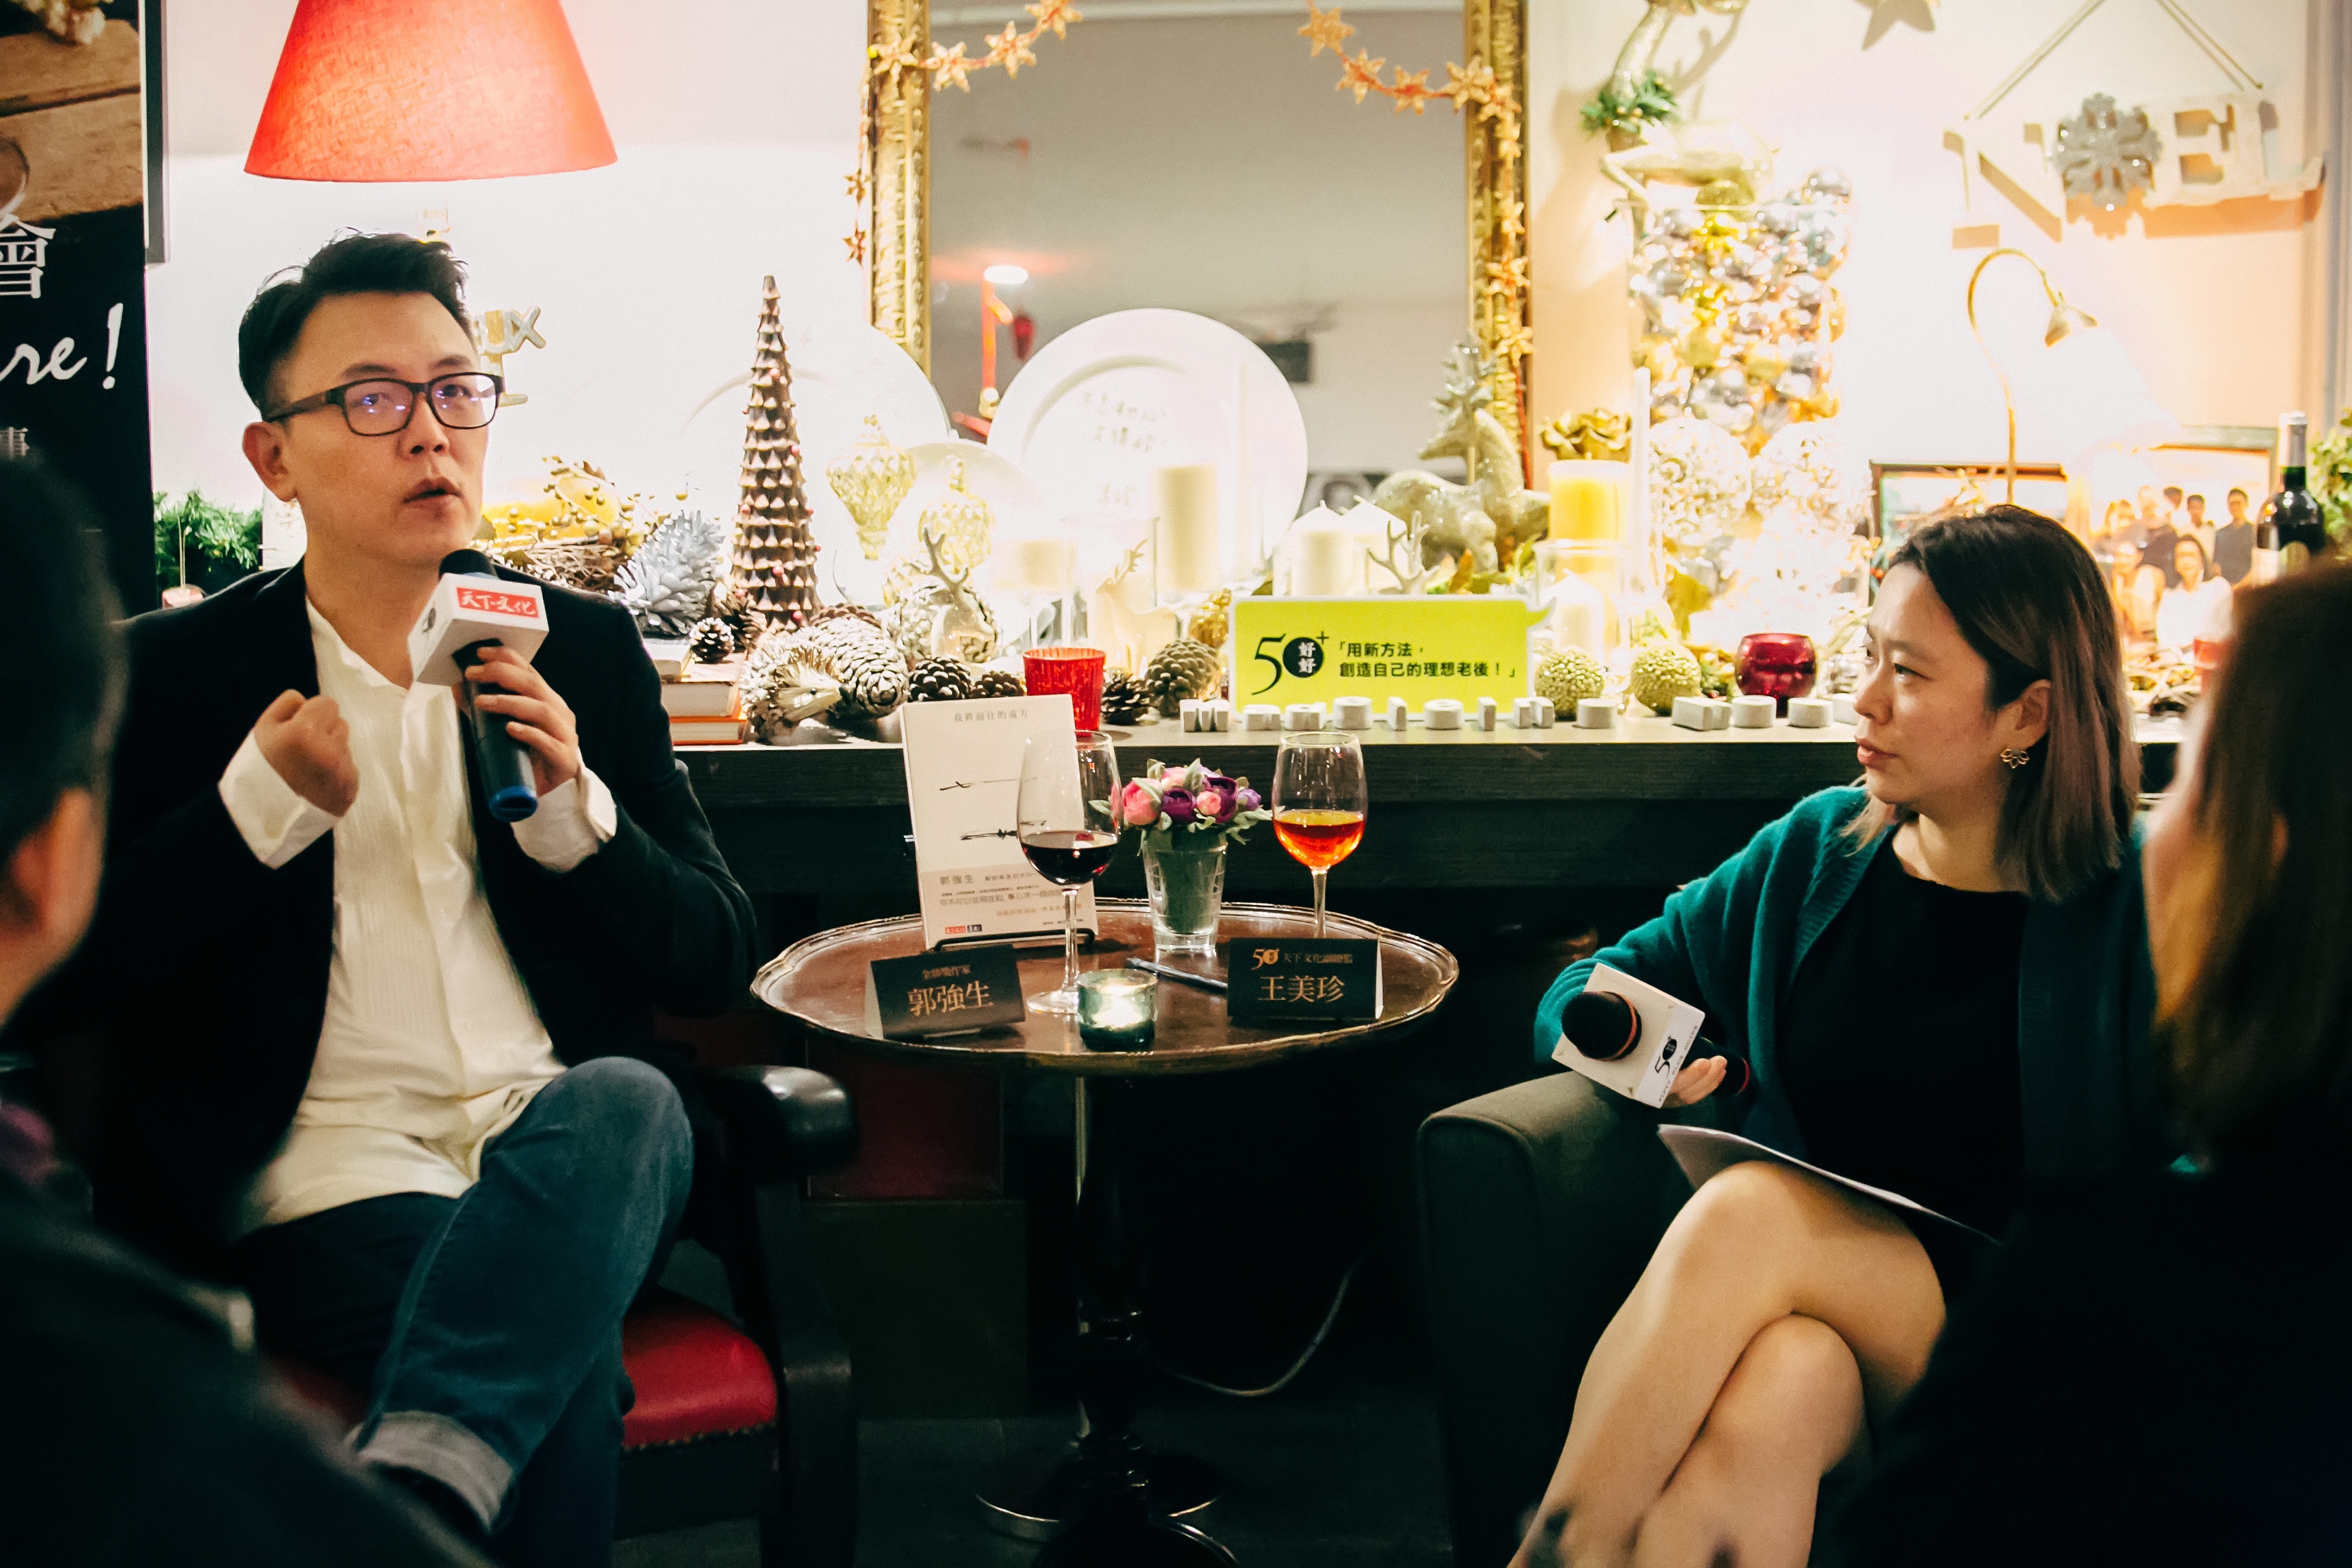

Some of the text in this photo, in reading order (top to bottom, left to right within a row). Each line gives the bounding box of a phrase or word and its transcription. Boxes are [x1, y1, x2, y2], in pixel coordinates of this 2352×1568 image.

[461, 590, 536, 616] 天下文化
[908, 981, 994, 1016] 郭強生
[1258, 975, 1345, 1003] 王美珍
